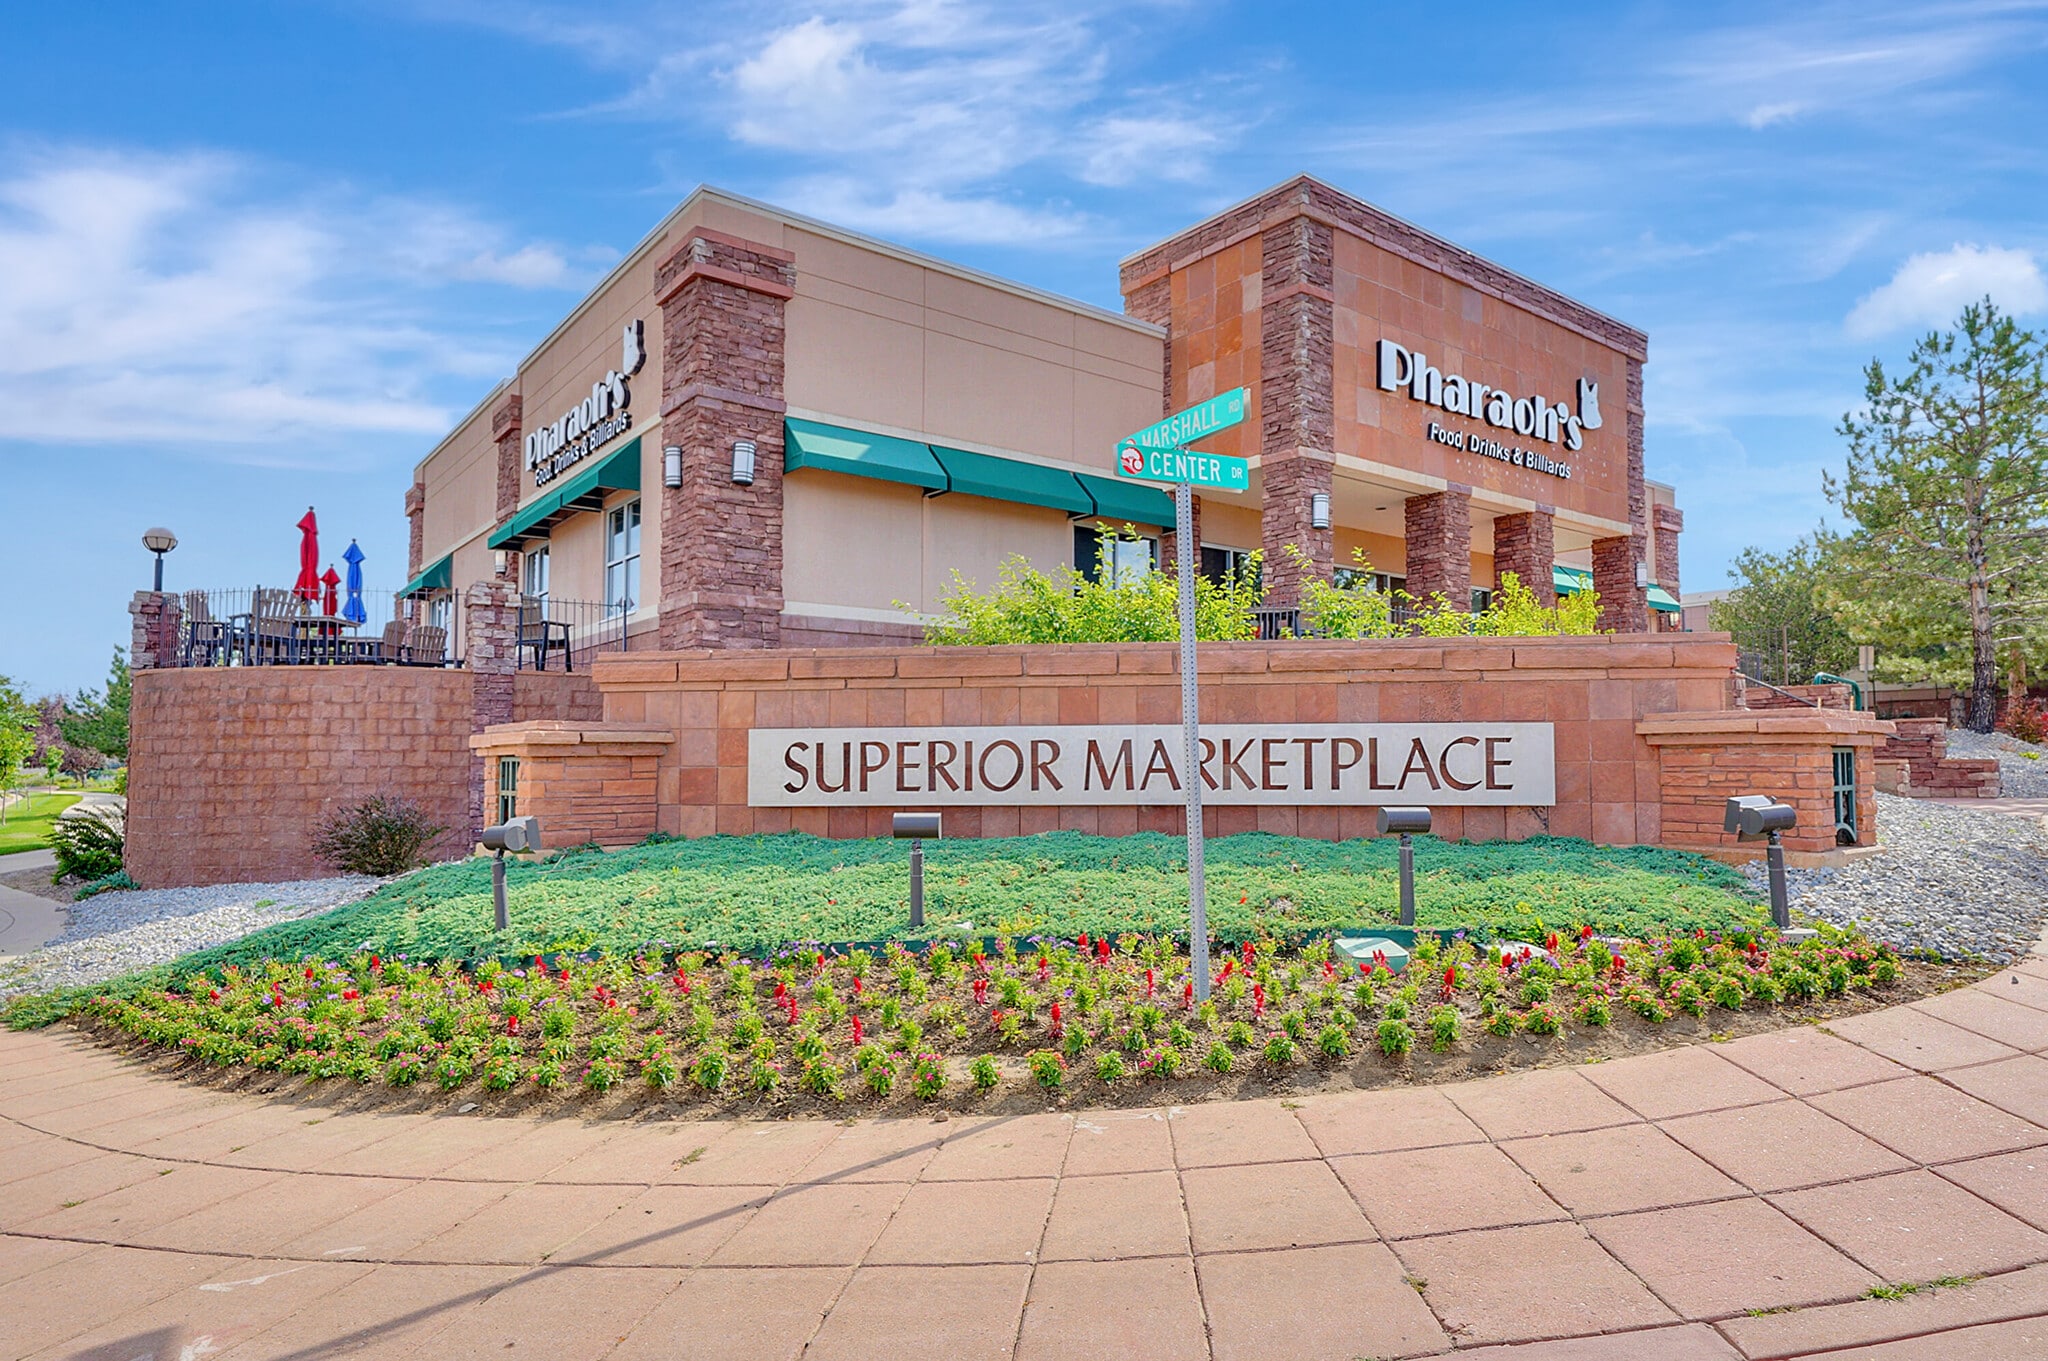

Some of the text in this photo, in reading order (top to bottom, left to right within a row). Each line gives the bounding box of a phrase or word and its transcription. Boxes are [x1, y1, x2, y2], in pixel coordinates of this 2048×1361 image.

[526, 370, 631, 472] Pharaoh's
[1376, 338, 1584, 451] Pharaoh's
[554, 446, 580, 473] Drinks
[580, 436, 590, 456] &
[590, 411, 632, 449] Billiards
[1142, 399, 1240, 449] MARSHALL RD
[1429, 422, 1572, 479] Food, Drinks & Billiards
[1150, 451, 1243, 482] CENTER DR
[783, 736, 1514, 794] SUPERIOR MARKETPLACE
